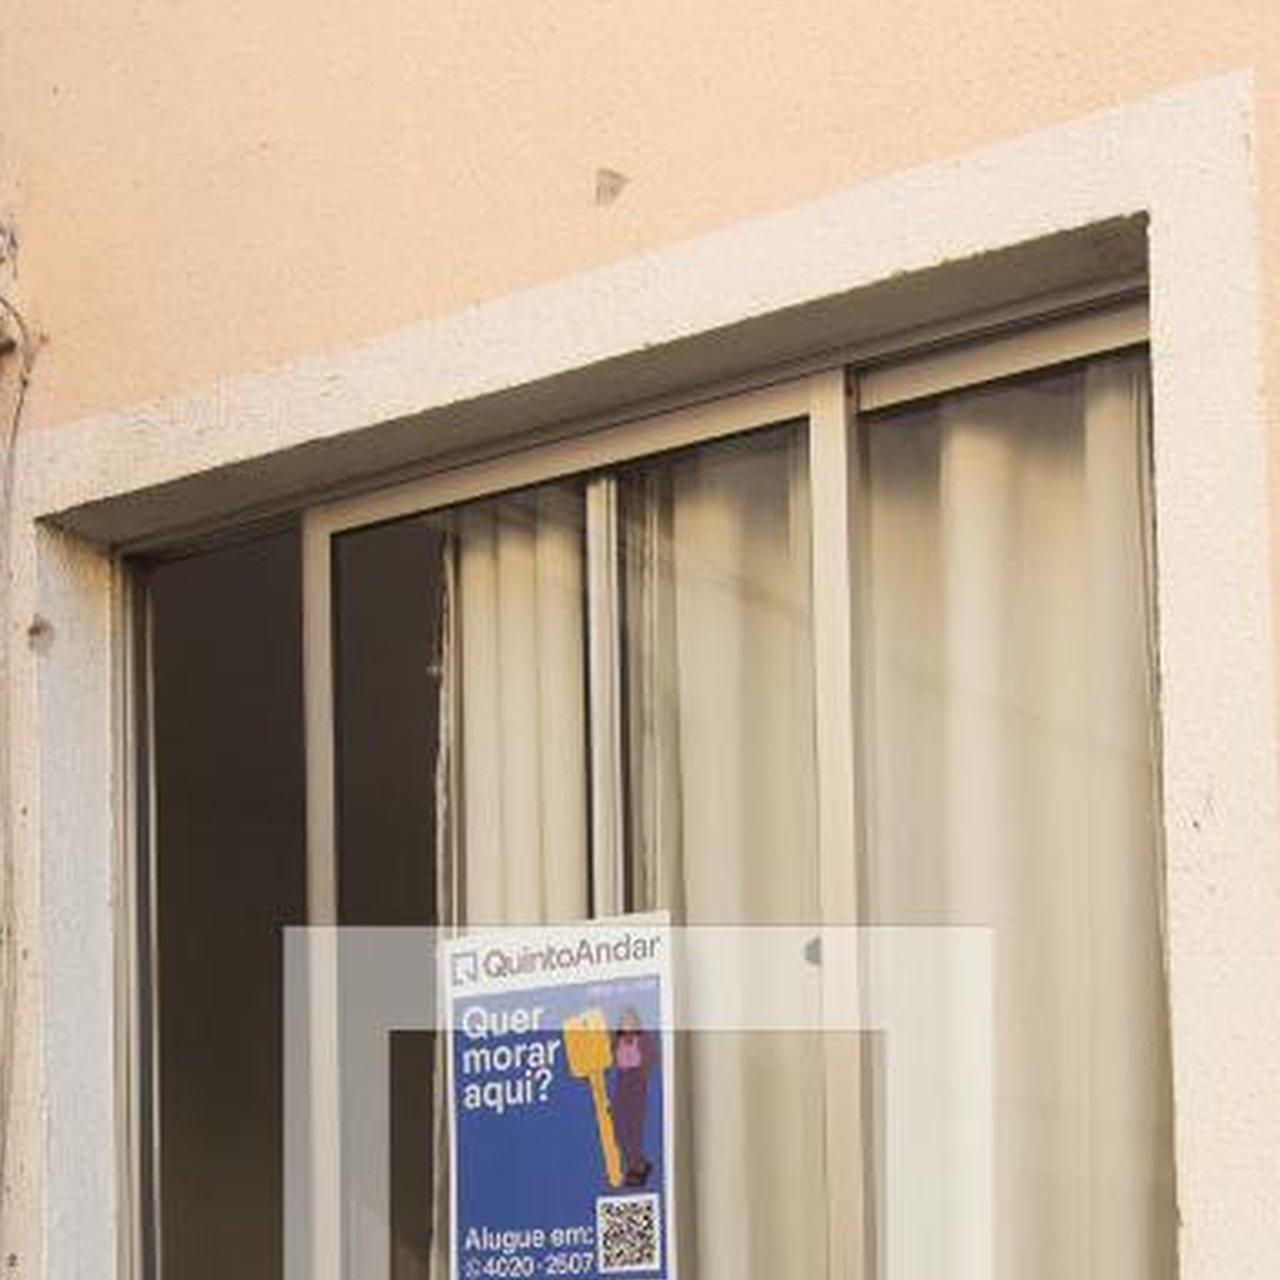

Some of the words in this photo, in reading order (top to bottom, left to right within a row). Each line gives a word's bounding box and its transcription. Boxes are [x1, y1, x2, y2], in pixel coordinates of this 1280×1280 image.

[482, 935, 661, 978] QuintoAndar
[462, 1006, 545, 1039] Quer
[462, 1038, 561, 1075] morar
[463, 1069, 553, 1115] aqui?
[465, 1226, 545, 1256] Alugue
[550, 1226, 595, 1247] em:
